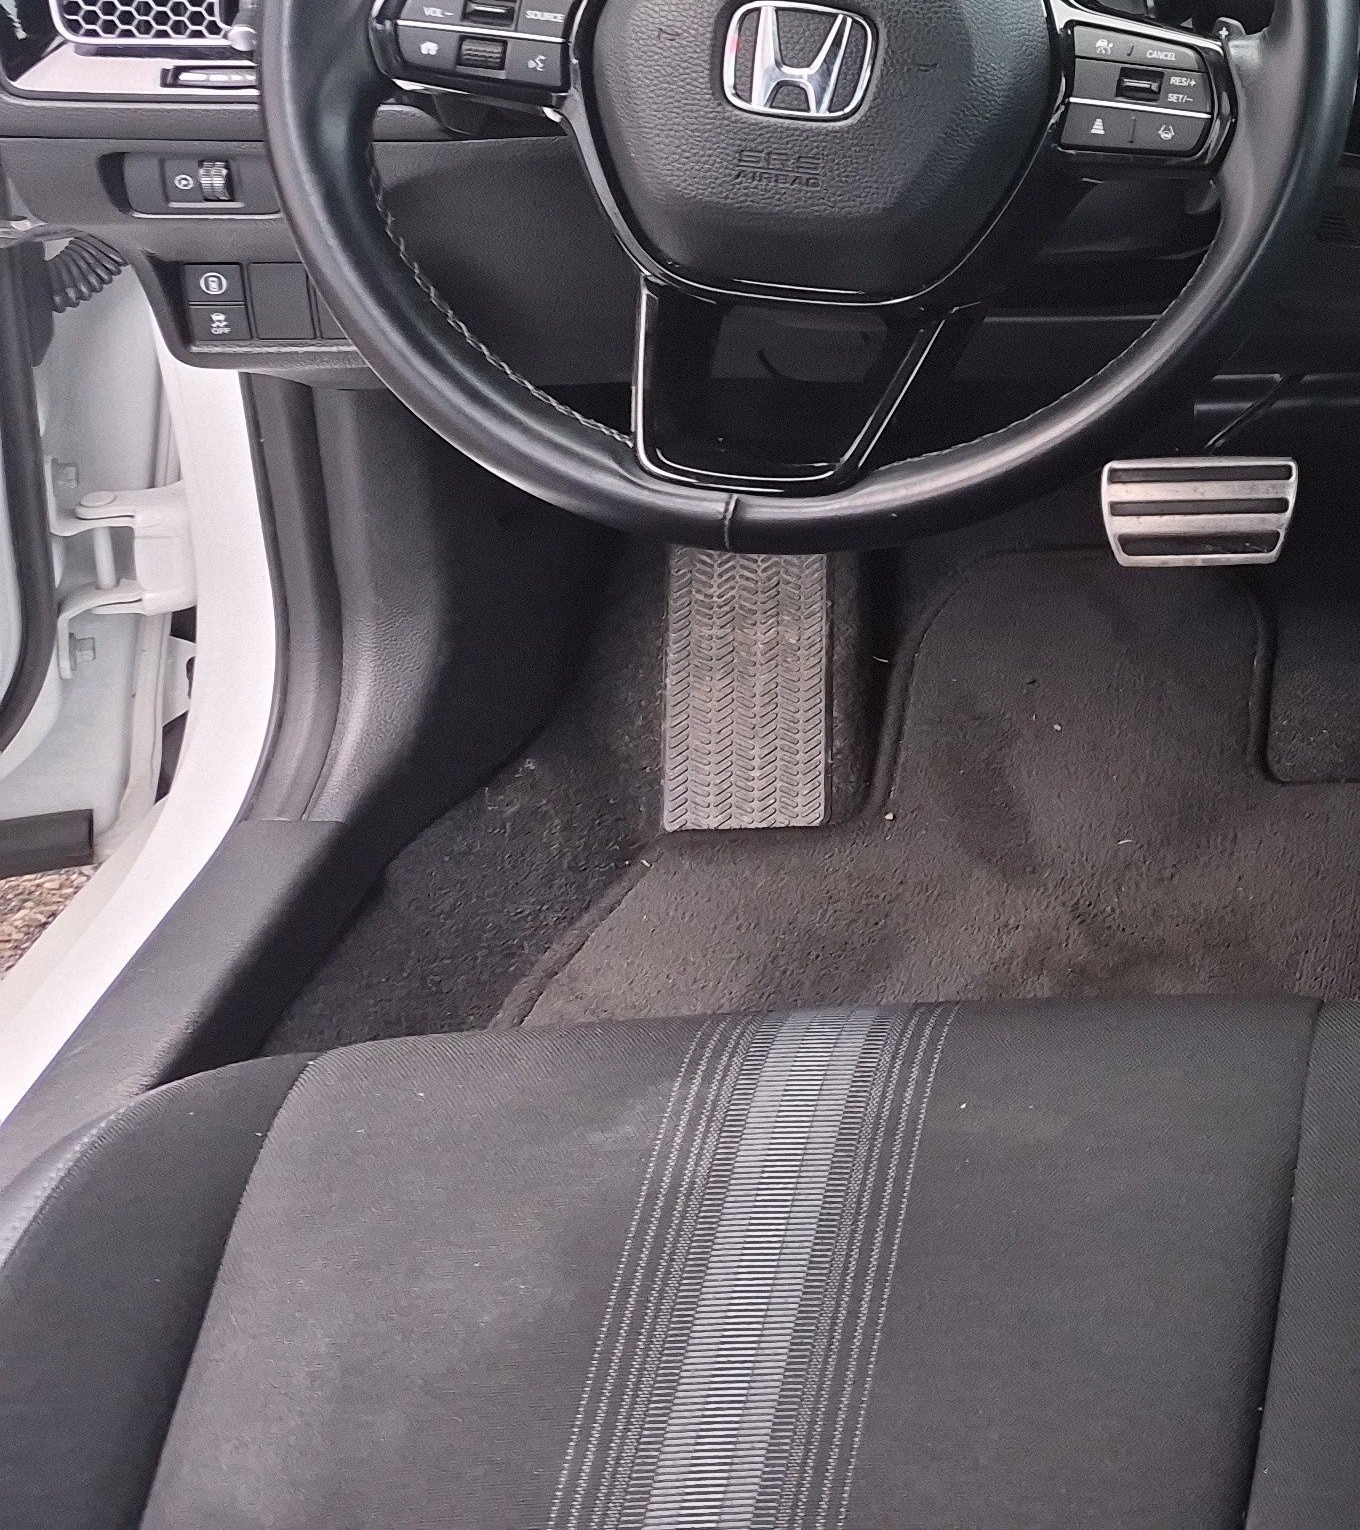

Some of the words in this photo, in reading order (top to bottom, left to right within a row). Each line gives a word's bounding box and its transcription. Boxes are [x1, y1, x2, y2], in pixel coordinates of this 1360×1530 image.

[525, 9, 565, 22] SOURCE
[1146, 49, 1177, 61] CANCEL
[210, 327, 231, 335] OFF
